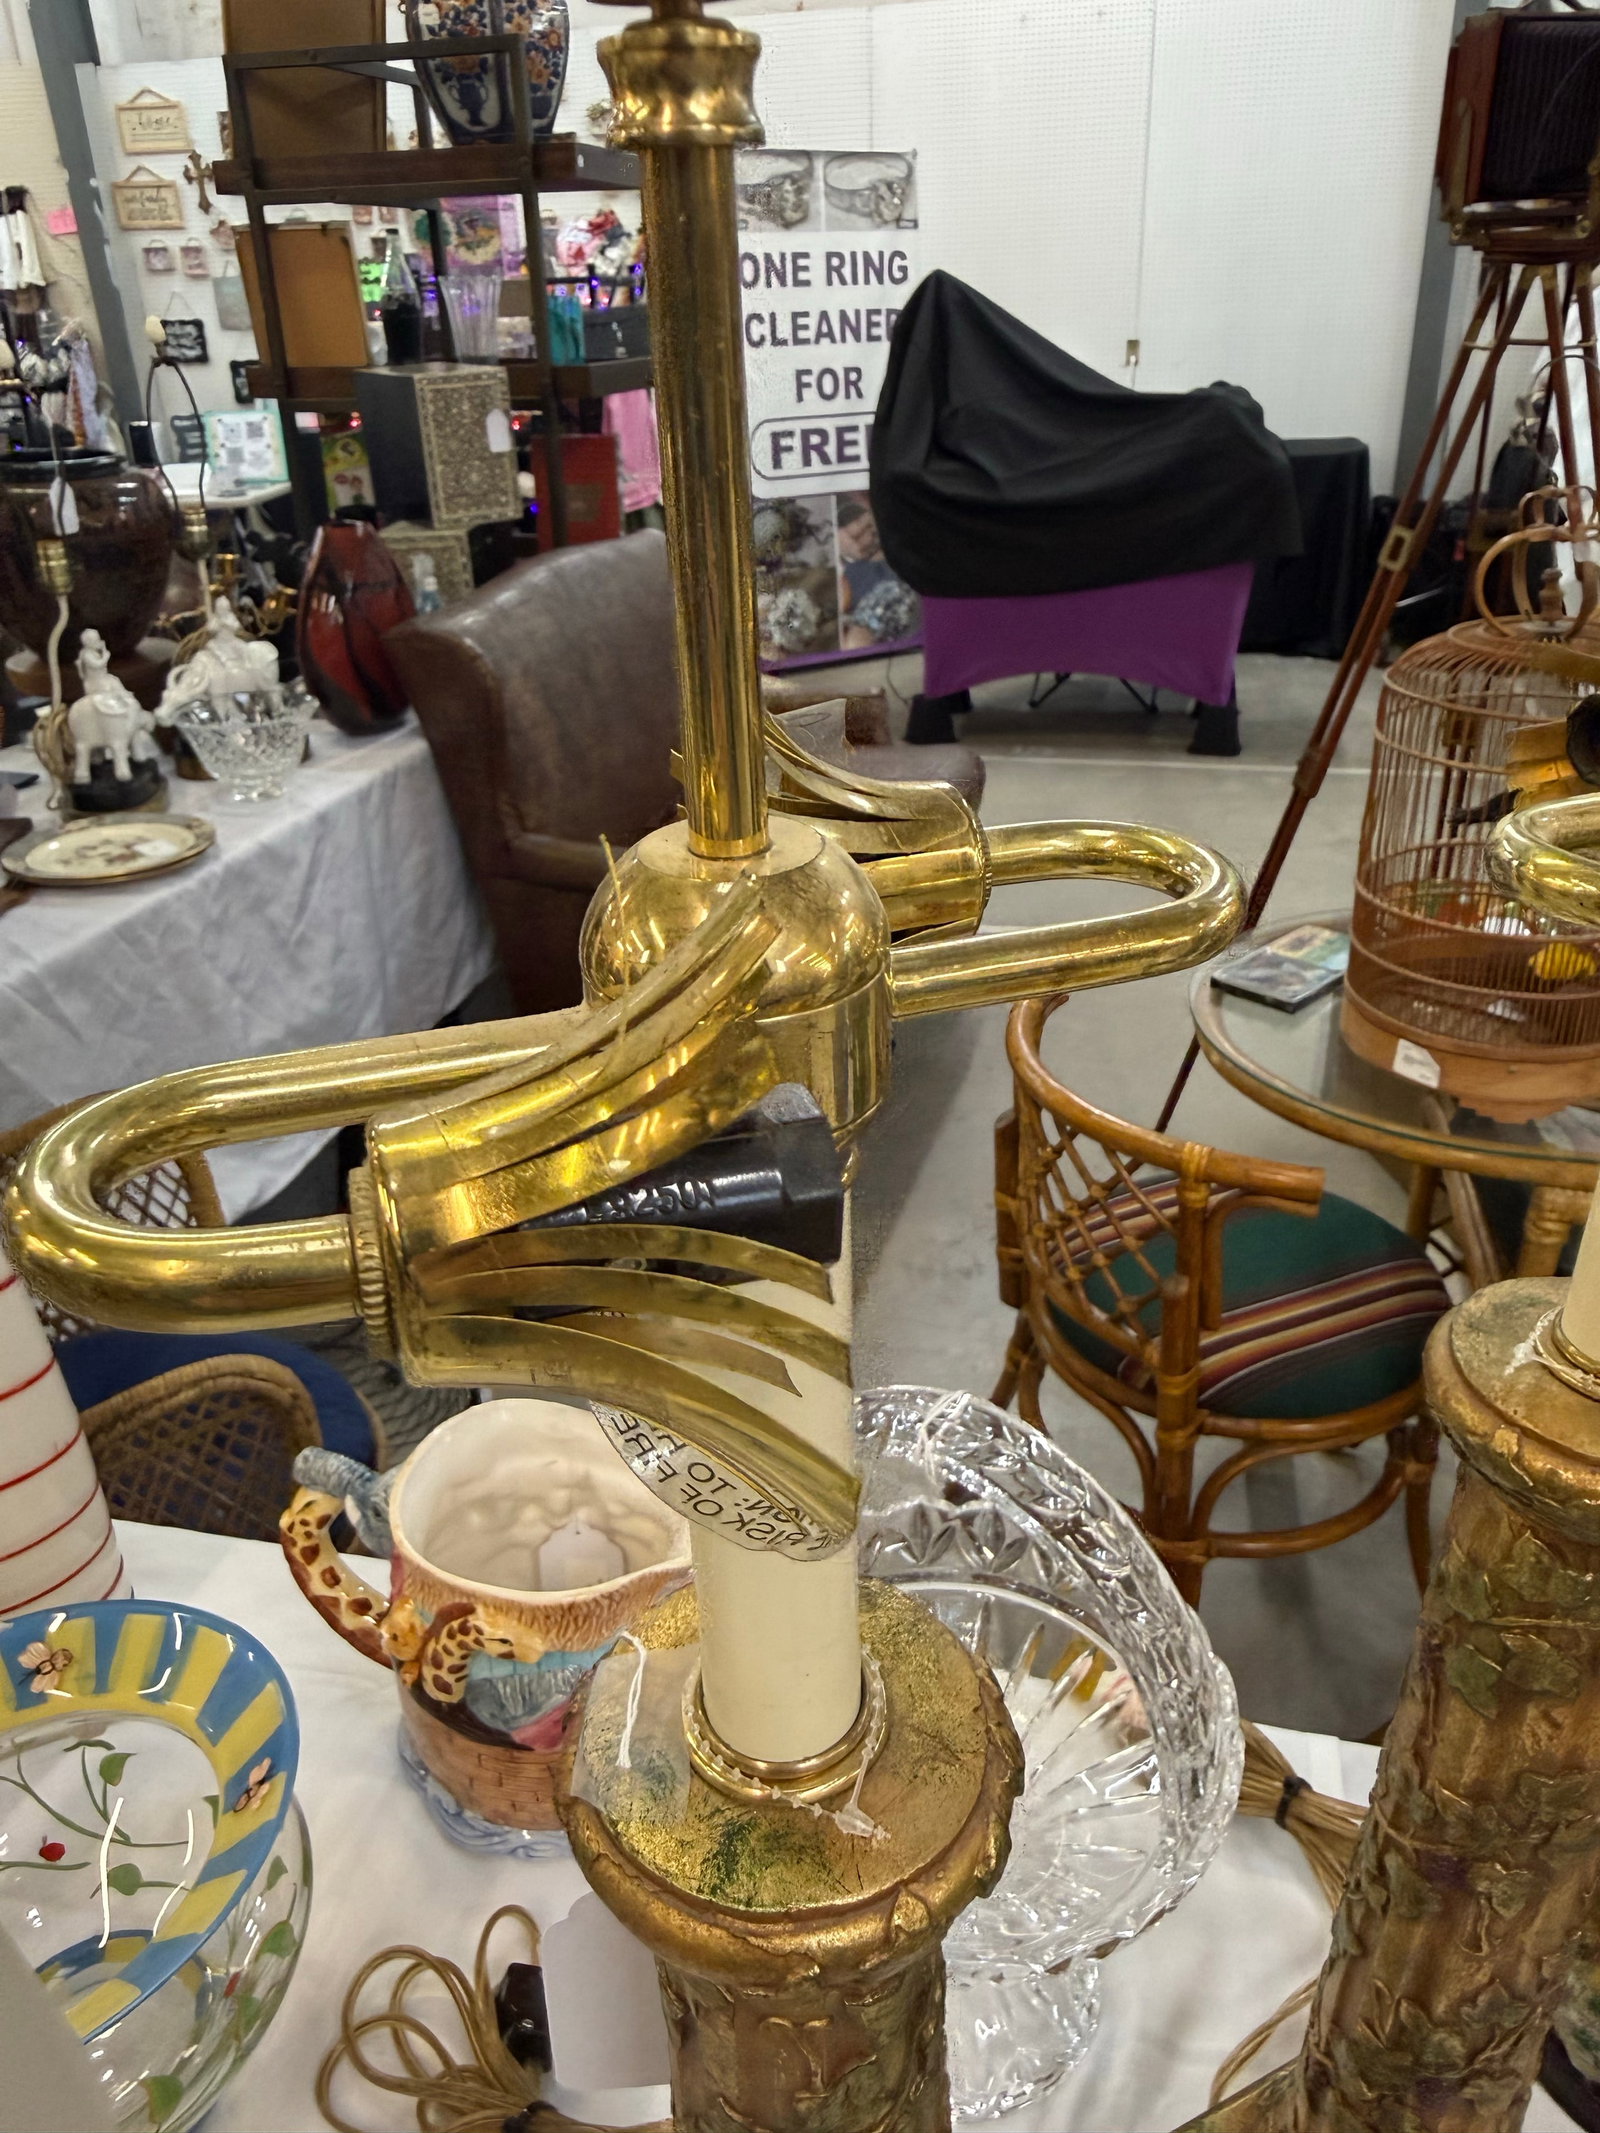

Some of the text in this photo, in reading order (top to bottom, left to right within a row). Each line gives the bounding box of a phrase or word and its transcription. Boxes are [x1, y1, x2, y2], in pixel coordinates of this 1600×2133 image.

[739, 250, 909, 290] ONE RING
[795, 366, 864, 403] FOR
[770, 423, 876, 470] FRE
